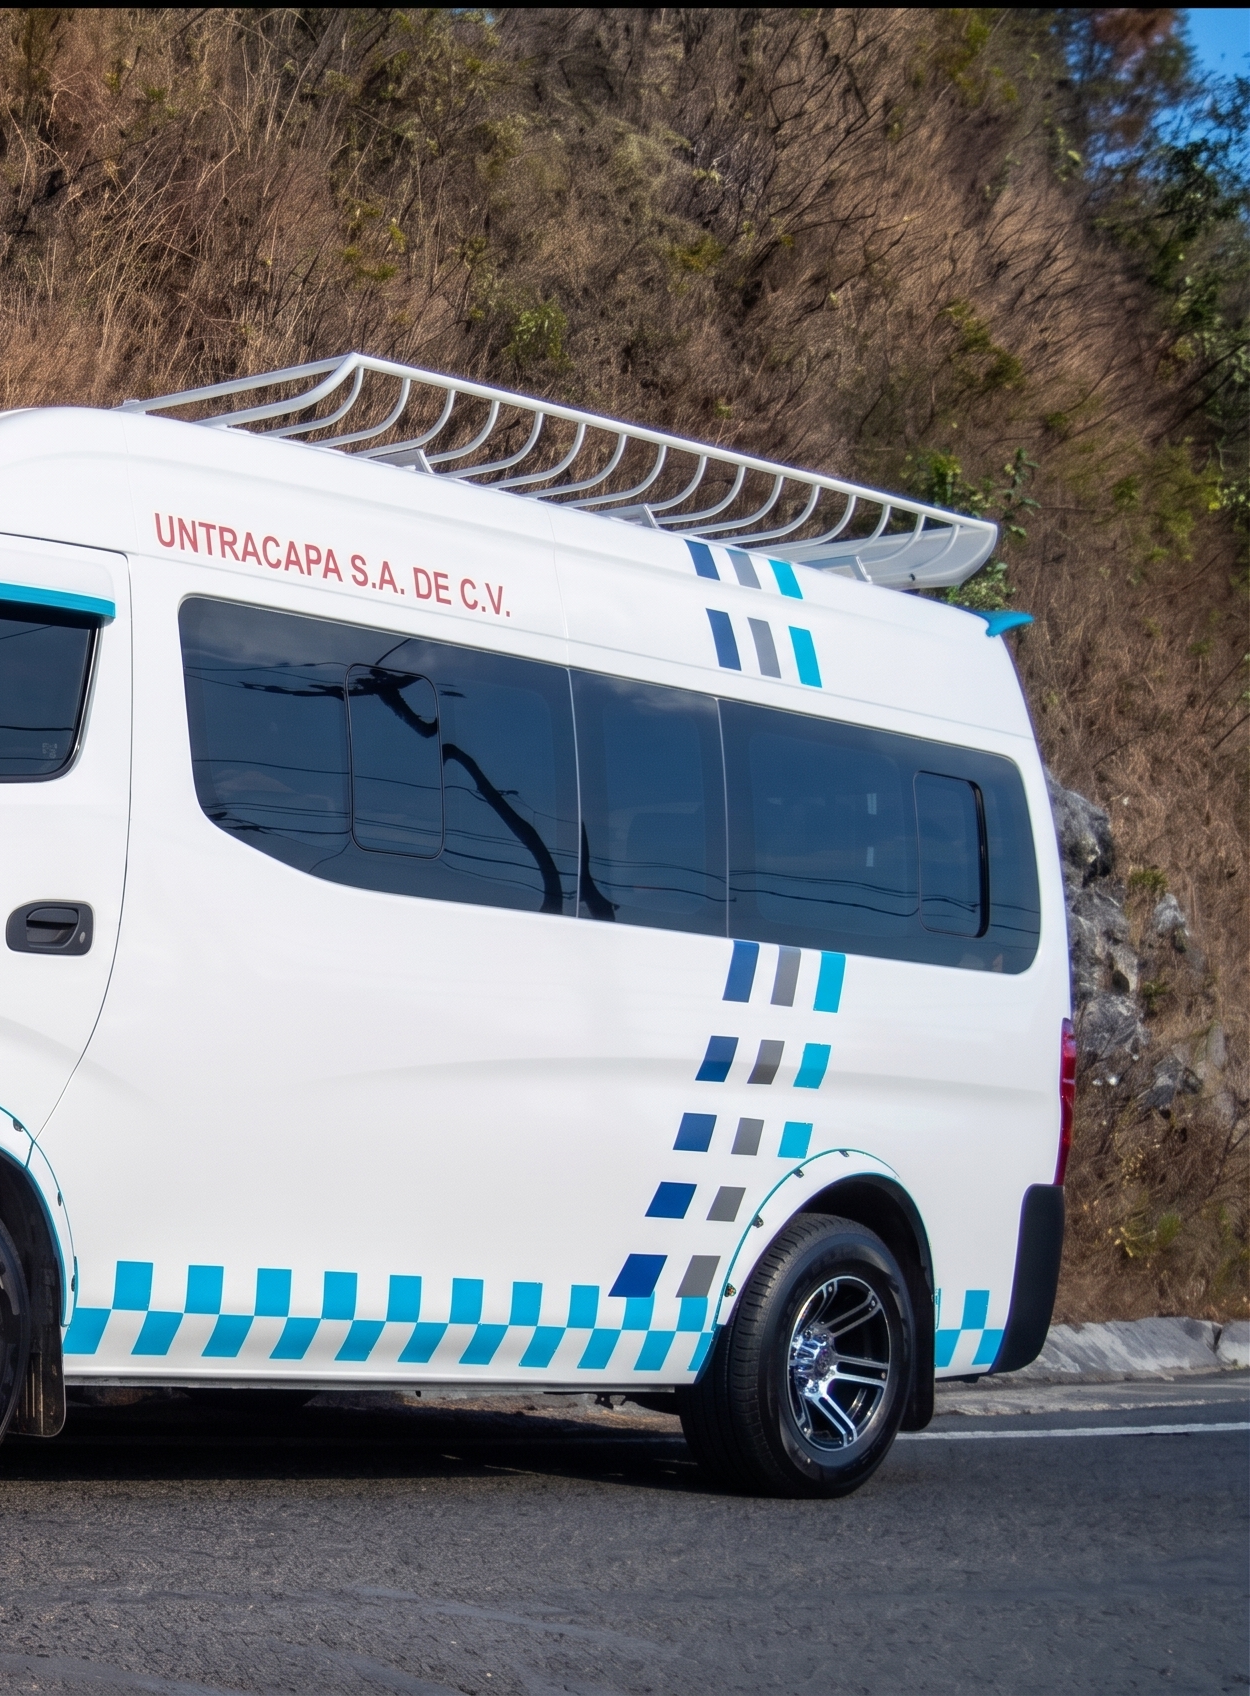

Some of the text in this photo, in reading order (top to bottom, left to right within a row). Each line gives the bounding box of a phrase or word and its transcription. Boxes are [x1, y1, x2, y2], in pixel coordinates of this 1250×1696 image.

[154, 512, 511, 618] UNTRACAPA S.A. DE C.V.
